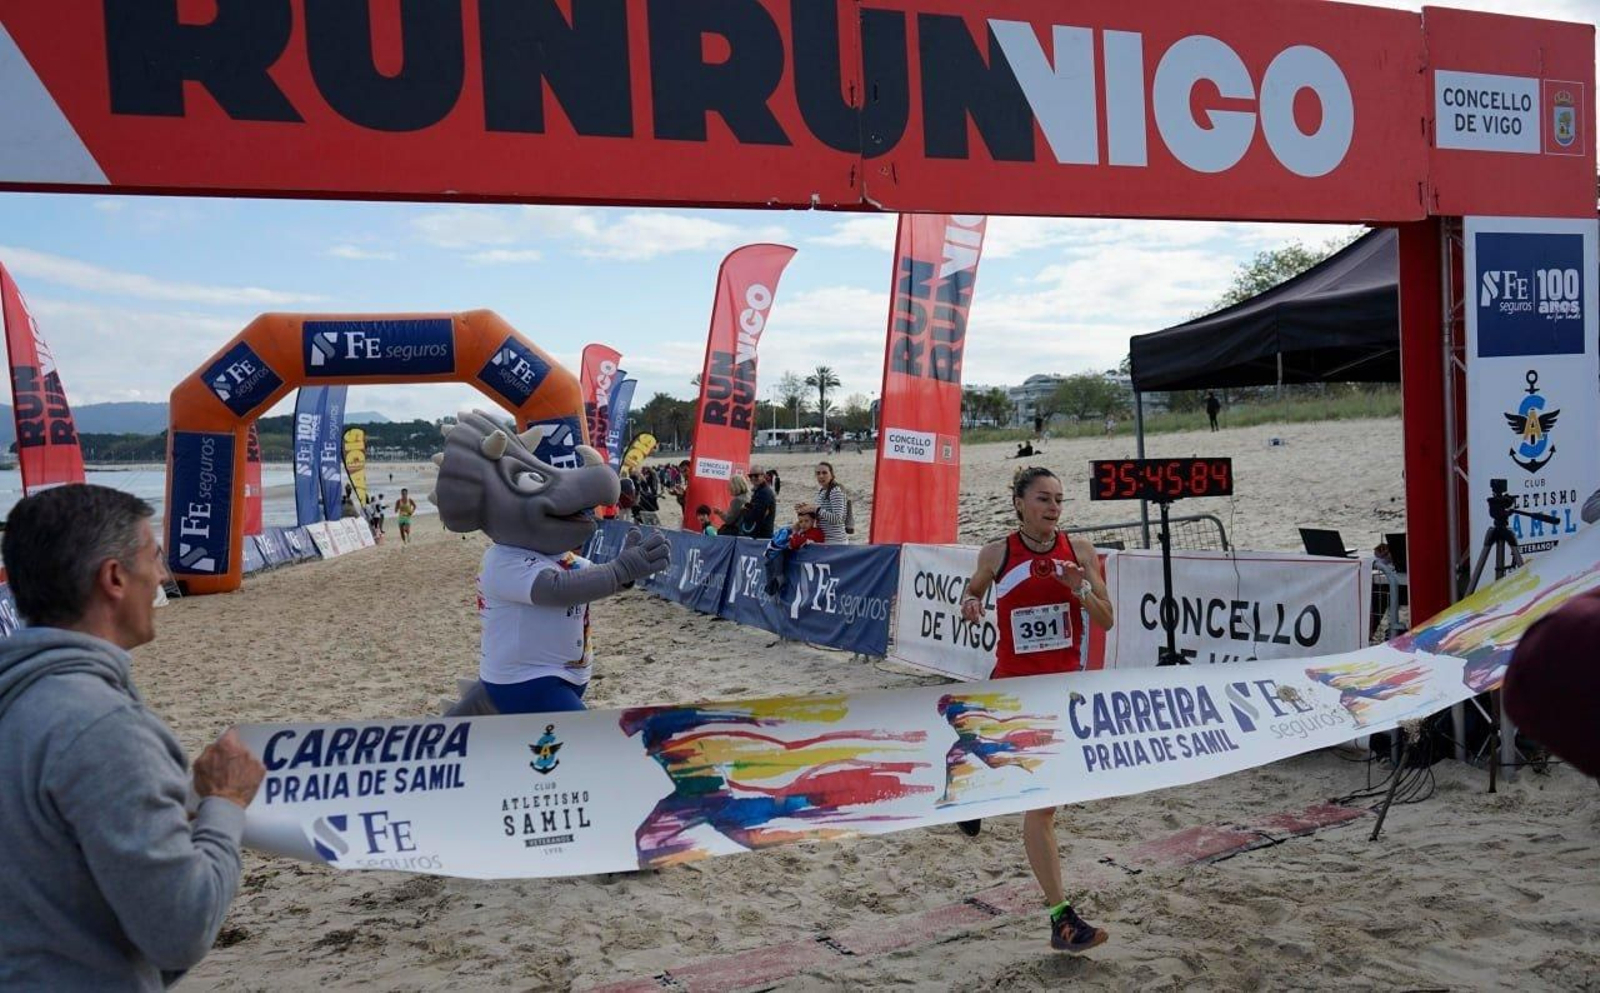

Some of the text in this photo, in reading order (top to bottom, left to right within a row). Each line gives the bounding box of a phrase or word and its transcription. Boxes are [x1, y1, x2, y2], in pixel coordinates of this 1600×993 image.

[1443, 88, 1532, 112] CONCELLO
[1454, 113, 1523, 135] DE VIGO
[1537, 268, 1580, 301] 100
[891, 257, 935, 377] RUN
[1500, 301, 1533, 315] seguros
[385, 343, 448, 361] seguros
[235, 366, 270, 398] seguros
[702, 350, 736, 427] RUN
[11, 366, 46, 447] RUN
[889, 434, 931, 447] CONCELLO
[894, 444, 906, 454] DE
[199, 437, 217, 499] seguros
[1524, 478, 1546, 488] CLUB
[1512, 508, 1577, 539] AMIL
[837, 595, 890, 625] seguros
[921, 610, 945, 641] DE
[1140, 592, 1322, 648] CONCELLO
[1020, 618, 1058, 639] 391
[1068, 684, 1224, 740] CARREIRA
[1269, 706, 1344, 740] seguros
[263, 722, 472, 771] CARREIRA
[1082, 728, 1240, 773] PRAIA DE SAMIL
[266, 763, 465, 805] PRAIA DE SAMIL
[534, 782, 557, 791] CLUB
[502, 790, 590, 811] ATLETISMO
[503, 807, 591, 836] SAMIL
